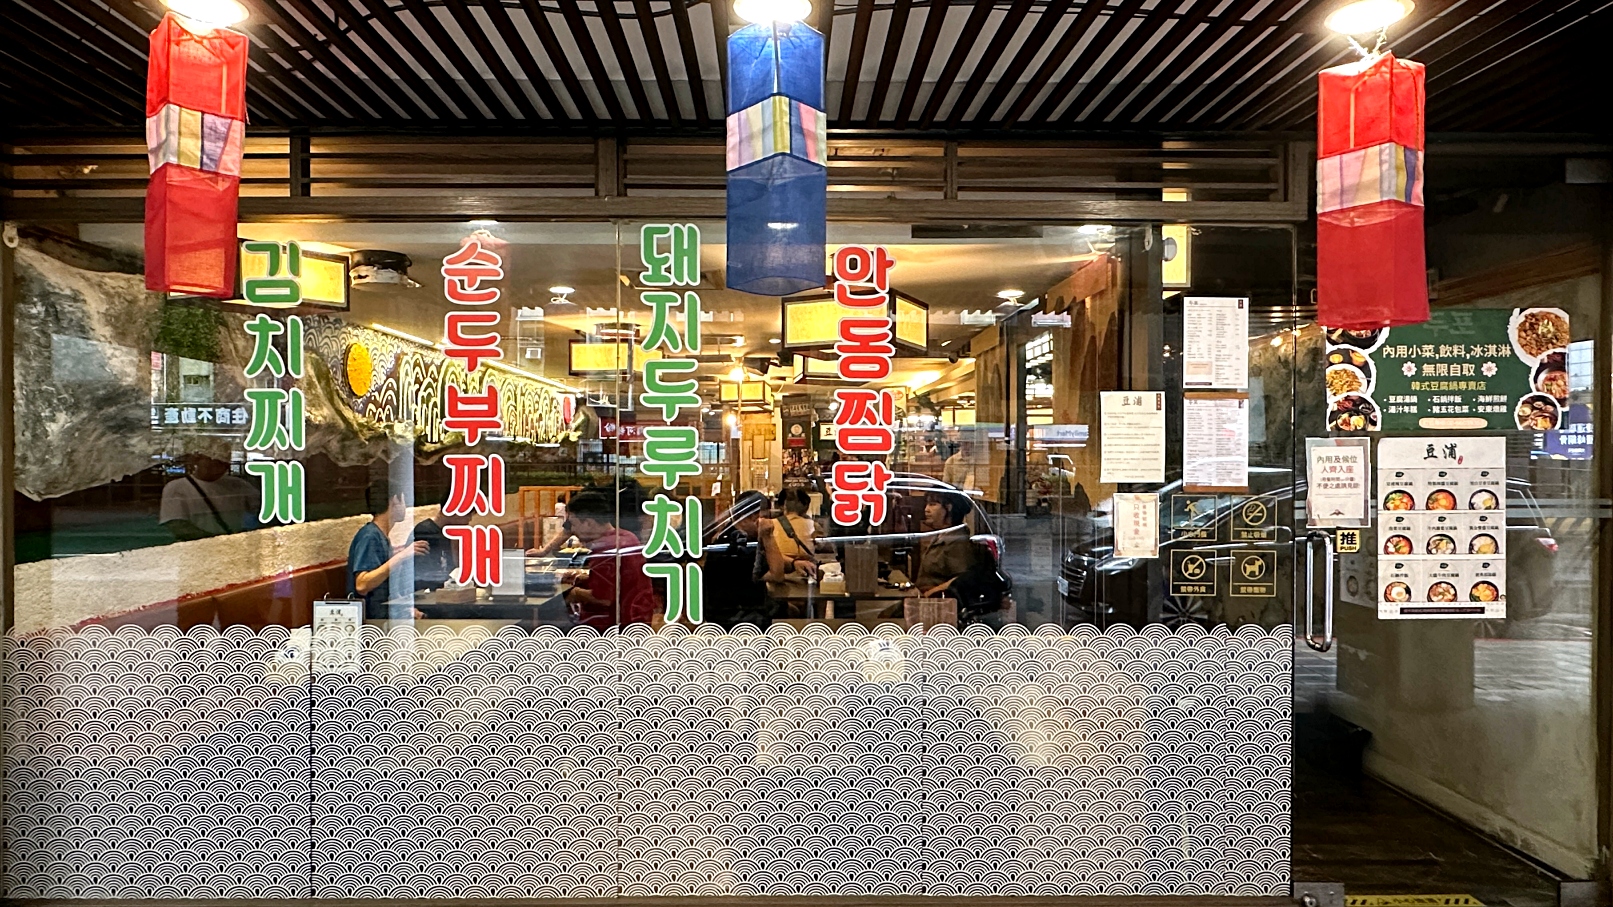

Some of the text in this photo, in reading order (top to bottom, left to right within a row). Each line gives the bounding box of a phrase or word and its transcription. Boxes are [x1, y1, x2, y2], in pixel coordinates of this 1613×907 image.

[1382, 344, 1512, 360] 內用小菜,飲料,冰淇淋
[1421, 363, 1476, 377] 無限自取
[242, 240, 306, 524] 김치찌개
[831, 244, 896, 527] 안동찜닭
[1410, 381, 1487, 391] 韓式豆腐鍋專賣店
[1432, 395, 1462, 403] 石鍋拌飯
[441, 240, 505, 587] 순두부찌개
[640, 223, 702, 624] 돼지두루치기
[1316, 455, 1358, 464] 內用及候位
[1423, 443, 1458, 461] 豆浦
[1321, 466, 1354, 474] 人齊入座
[1340, 531, 1357, 545] 推
